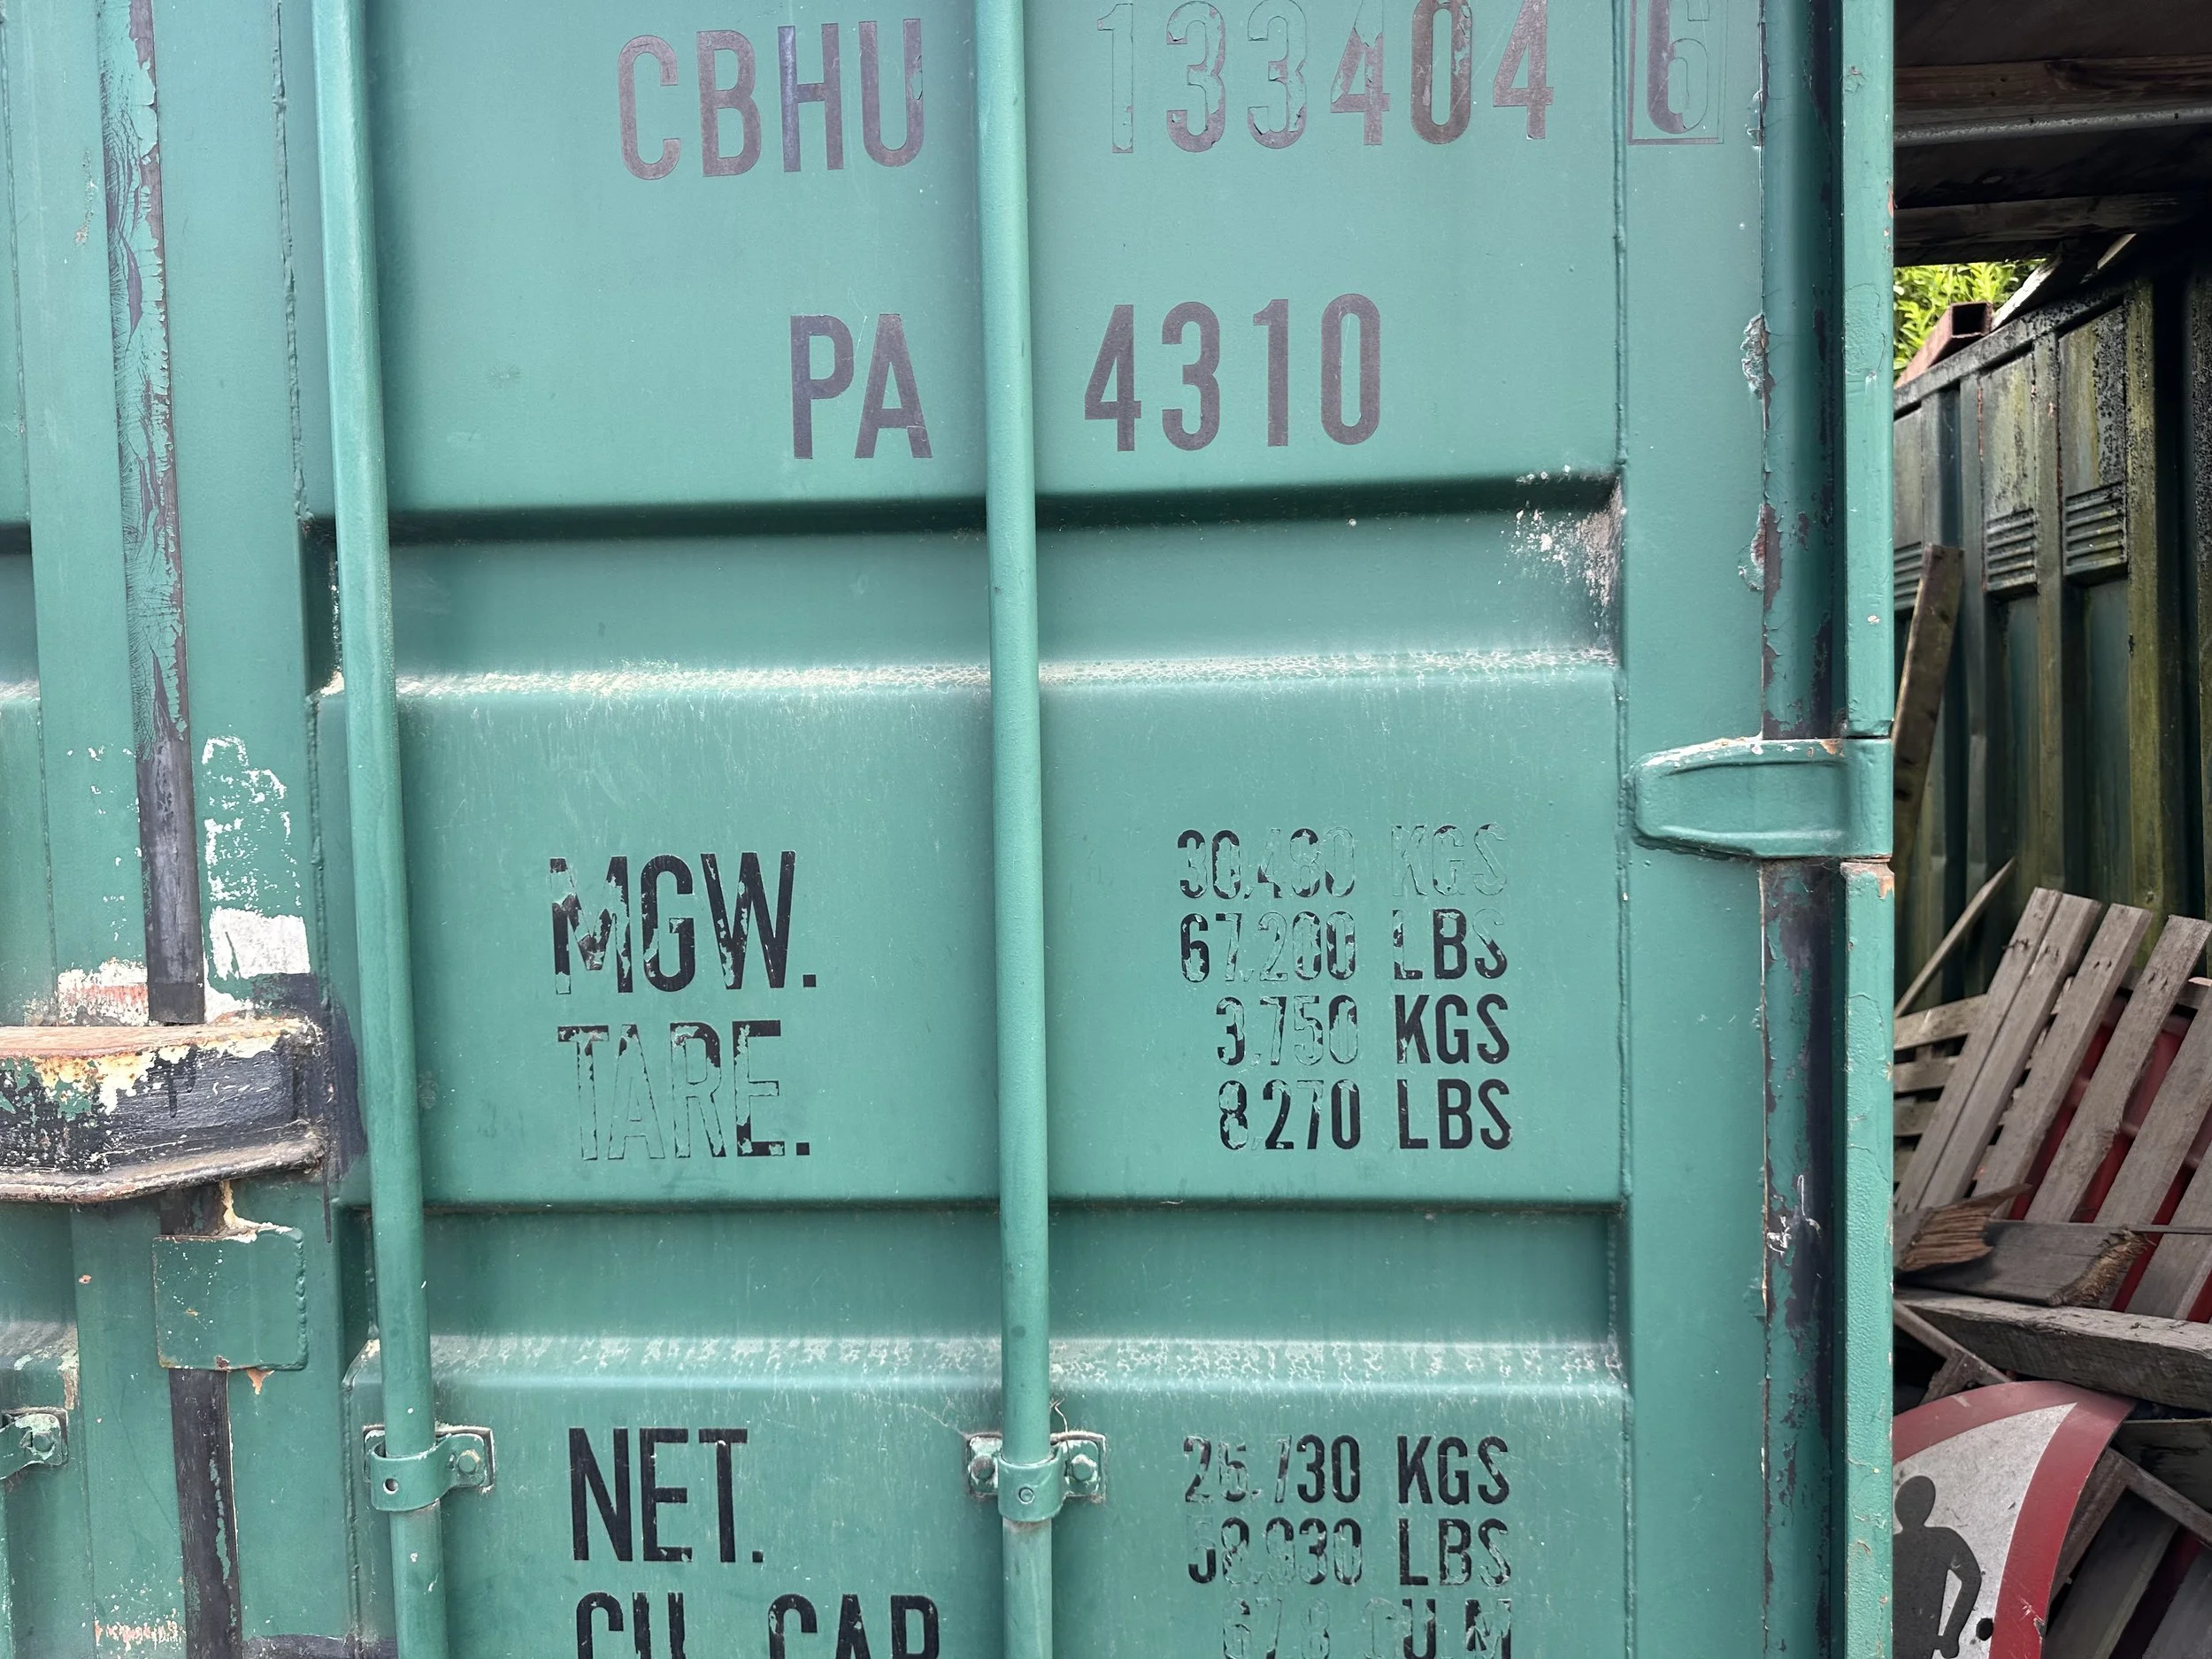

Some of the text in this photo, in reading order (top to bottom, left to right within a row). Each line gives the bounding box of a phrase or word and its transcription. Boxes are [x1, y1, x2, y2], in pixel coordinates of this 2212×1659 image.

[618, 18, 925, 180] CBHU
[1097, 0, 1555, 153] 133404
[790, 293, 1381, 459] PA 4310
[1391, 822, 1508, 896] KGS
[549, 849, 817, 995] MGW.
[1392, 908, 1508, 980] LBS
[1394, 993, 1510, 1064] KGS
[557, 1019, 811, 1161] TARE.
[1396, 1079, 1514, 1150] LBS
[568, 1426, 764, 1564] NET.
[1396, 1435, 1510, 1504] KGS
[1398, 1517, 1512, 1586] LBS
